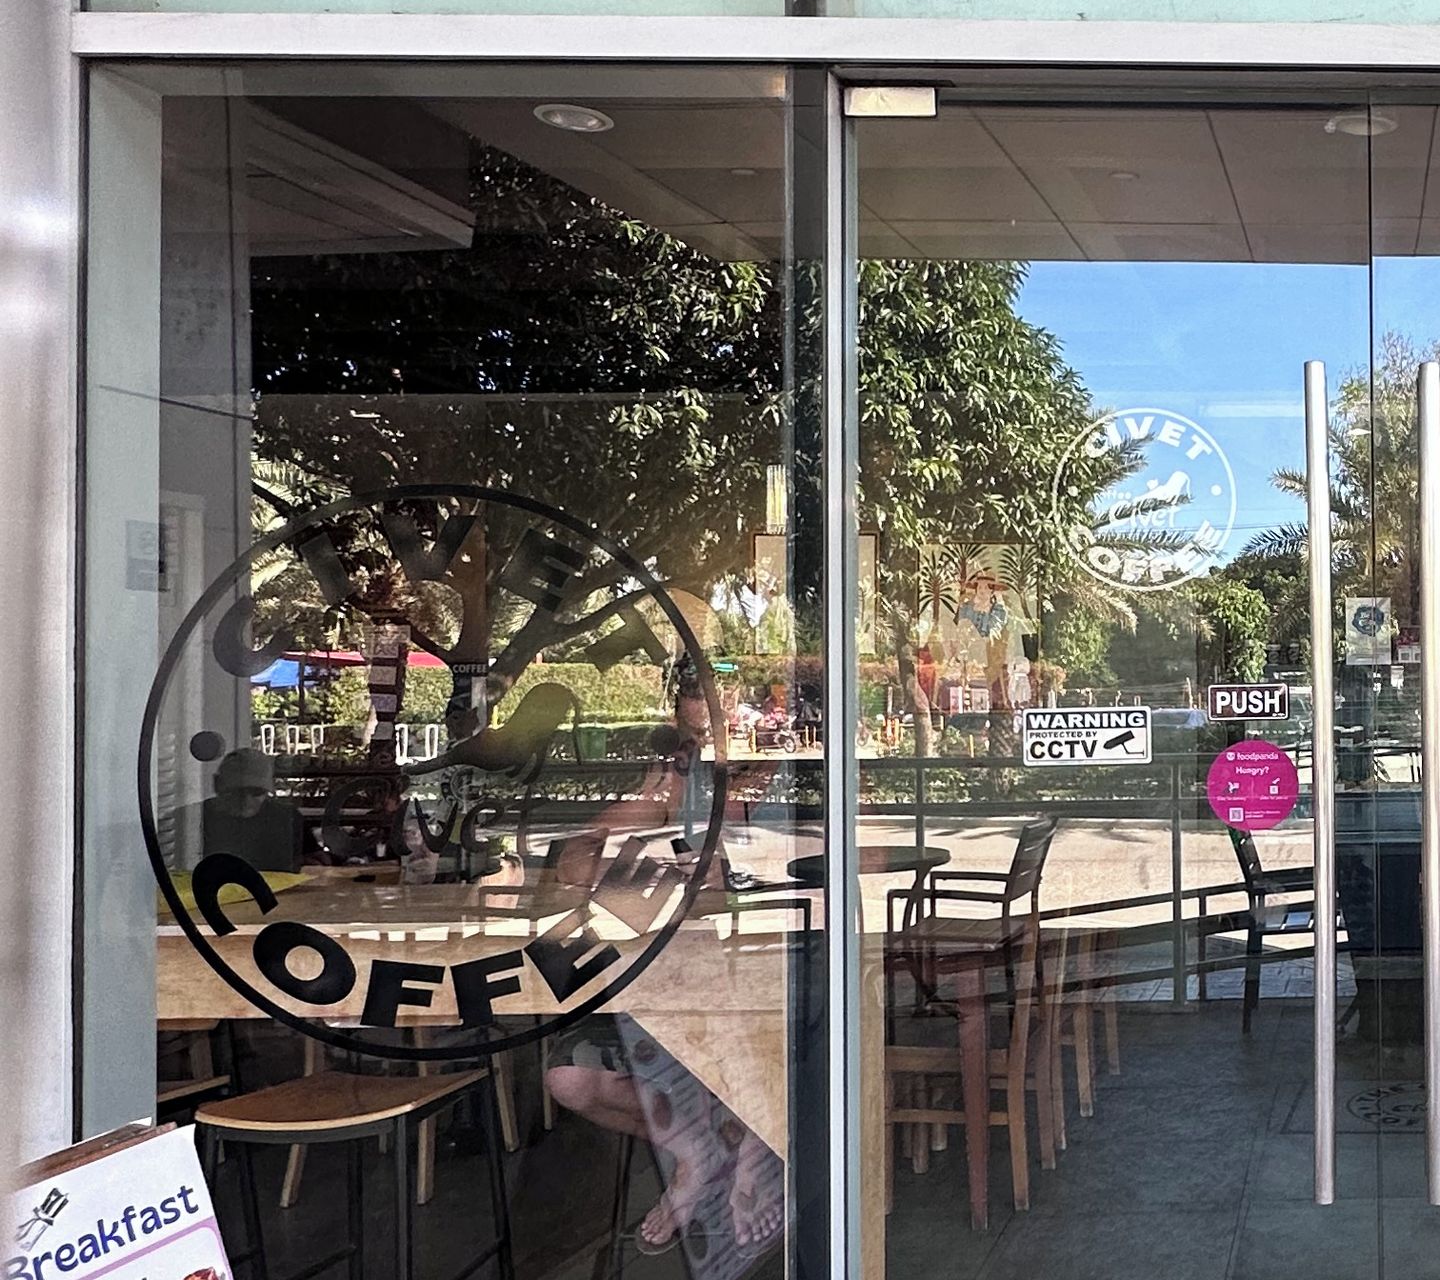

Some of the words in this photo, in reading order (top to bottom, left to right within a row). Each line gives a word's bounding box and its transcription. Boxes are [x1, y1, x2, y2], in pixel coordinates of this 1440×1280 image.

[452, 664, 487, 673] COFFEE
[1215, 690, 1280, 714] PUSH
[1028, 712, 1145, 728] WARNING
[1030, 740, 1098, 759] CCTV
[1236, 752, 1279, 761] foodpanda
